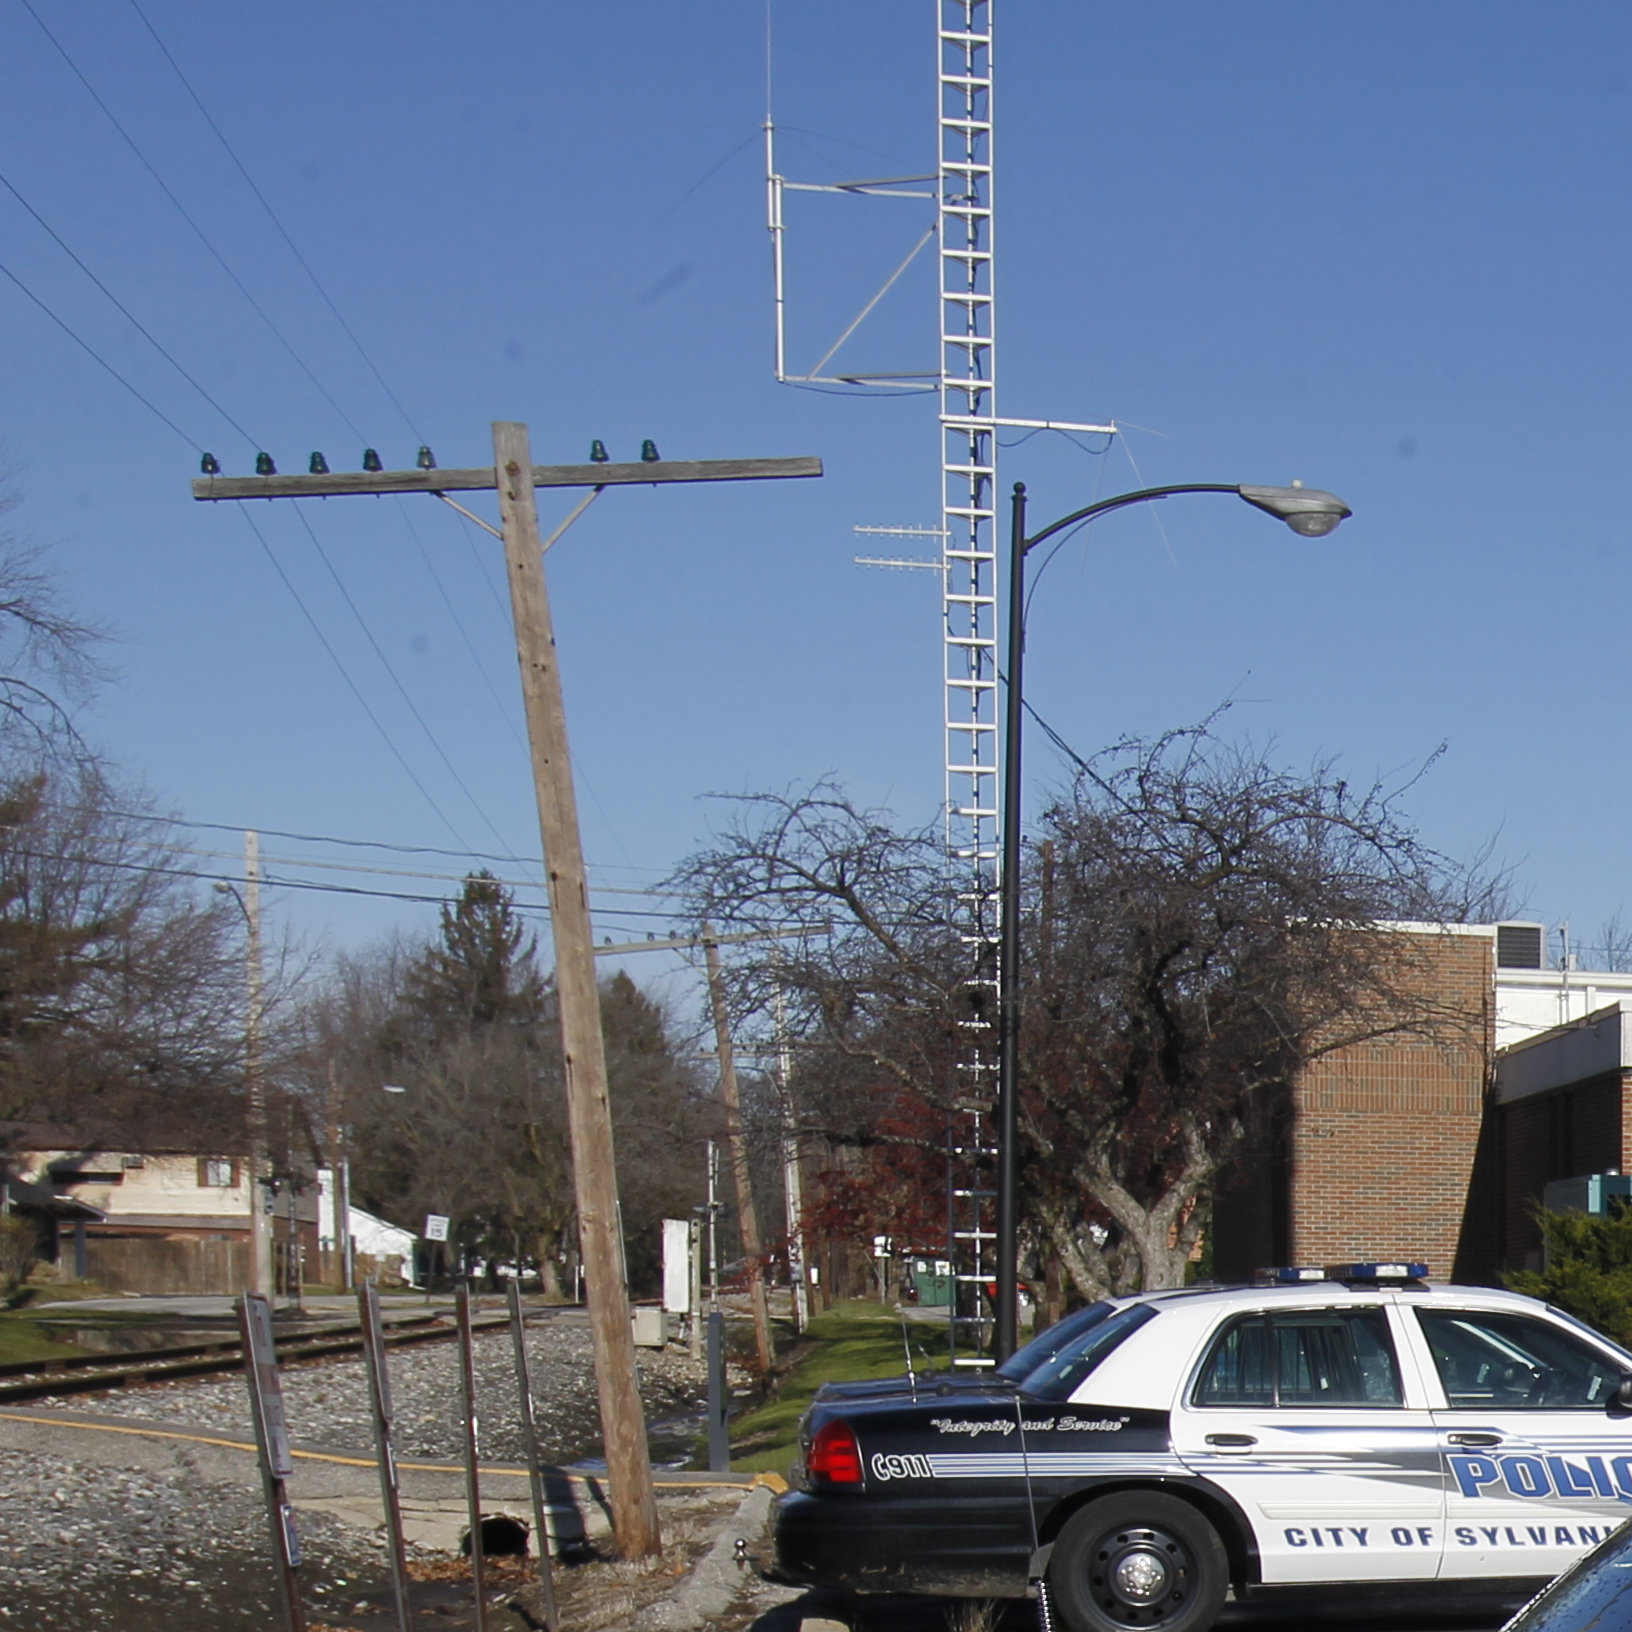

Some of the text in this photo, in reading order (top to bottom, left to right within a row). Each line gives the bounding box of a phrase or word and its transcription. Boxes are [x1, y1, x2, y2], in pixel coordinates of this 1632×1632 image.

[885, 1453, 931, 1478] 911
[1283, 1526, 1369, 1548] CITY
[1390, 1526, 1435, 1547] OF
